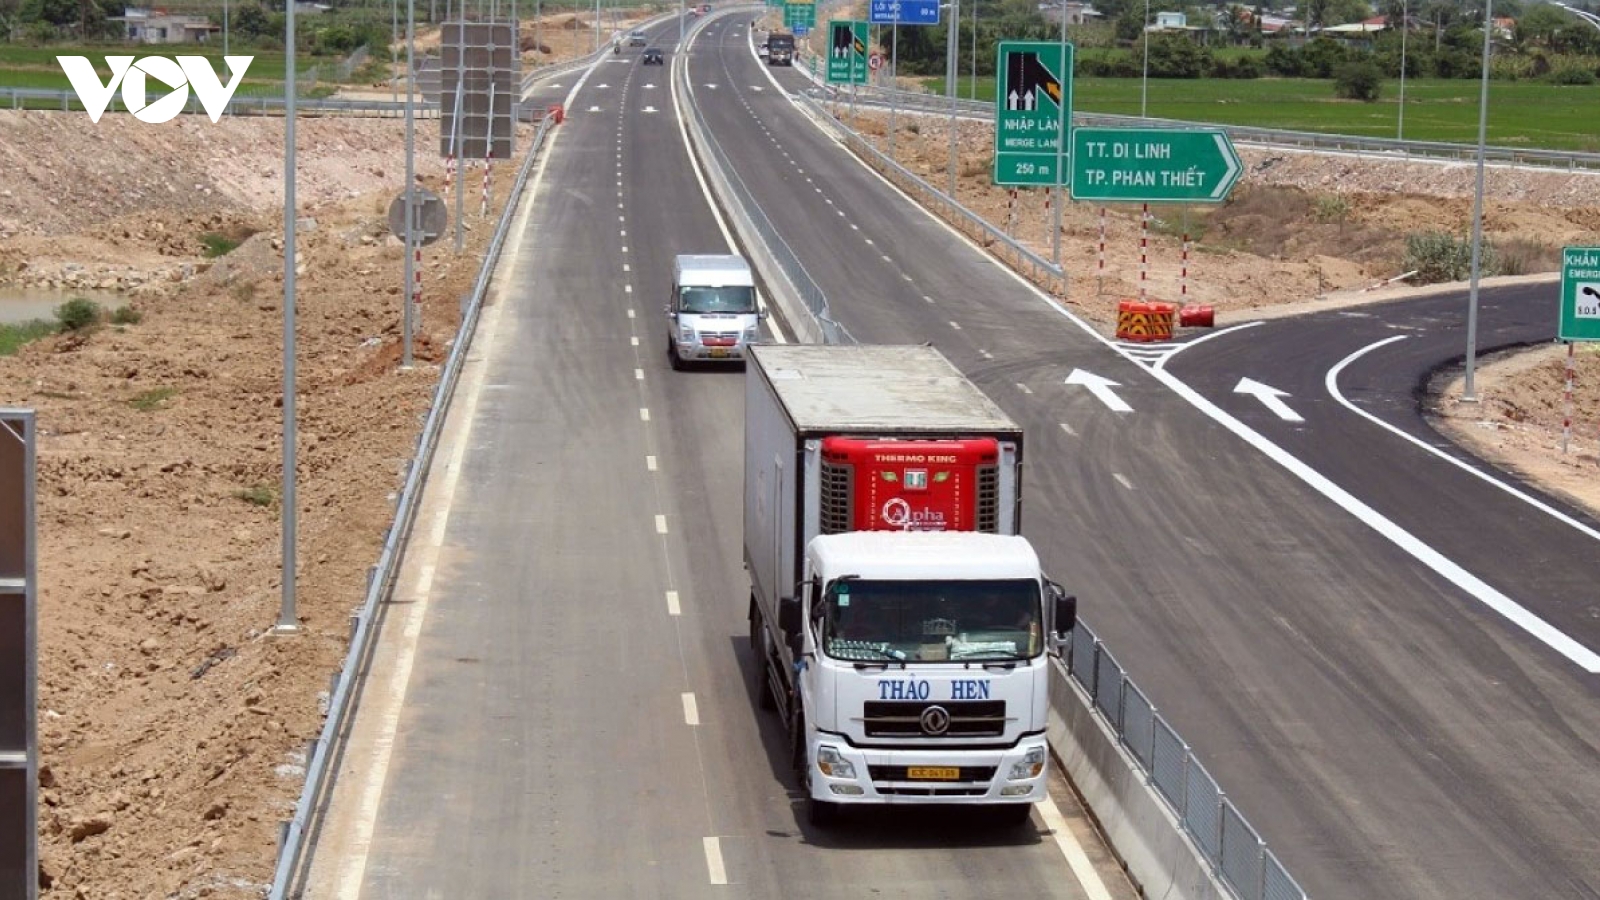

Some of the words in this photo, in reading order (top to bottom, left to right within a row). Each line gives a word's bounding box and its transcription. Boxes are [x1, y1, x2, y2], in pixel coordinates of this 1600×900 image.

[1005, 115, 1035, 133] NHẬP
[1005, 137, 1035, 147] MERGE
[1037, 137, 1058, 148] LAN
[1085, 141, 1108, 158] TT.
[1113, 142, 1129, 158] DI
[1135, 143, 1170, 159] LINH
[1016, 162, 1034, 175] 250
[1038, 165, 1050, 175] m
[1085, 170, 1108, 186] TP.
[1113, 171, 1156, 187] PHAN
[1161, 164, 1206, 187] THIẾT
[875, 454, 926, 463] THERMO
[927, 455, 957, 463] KING
[950, 680, 990, 700] HEN
